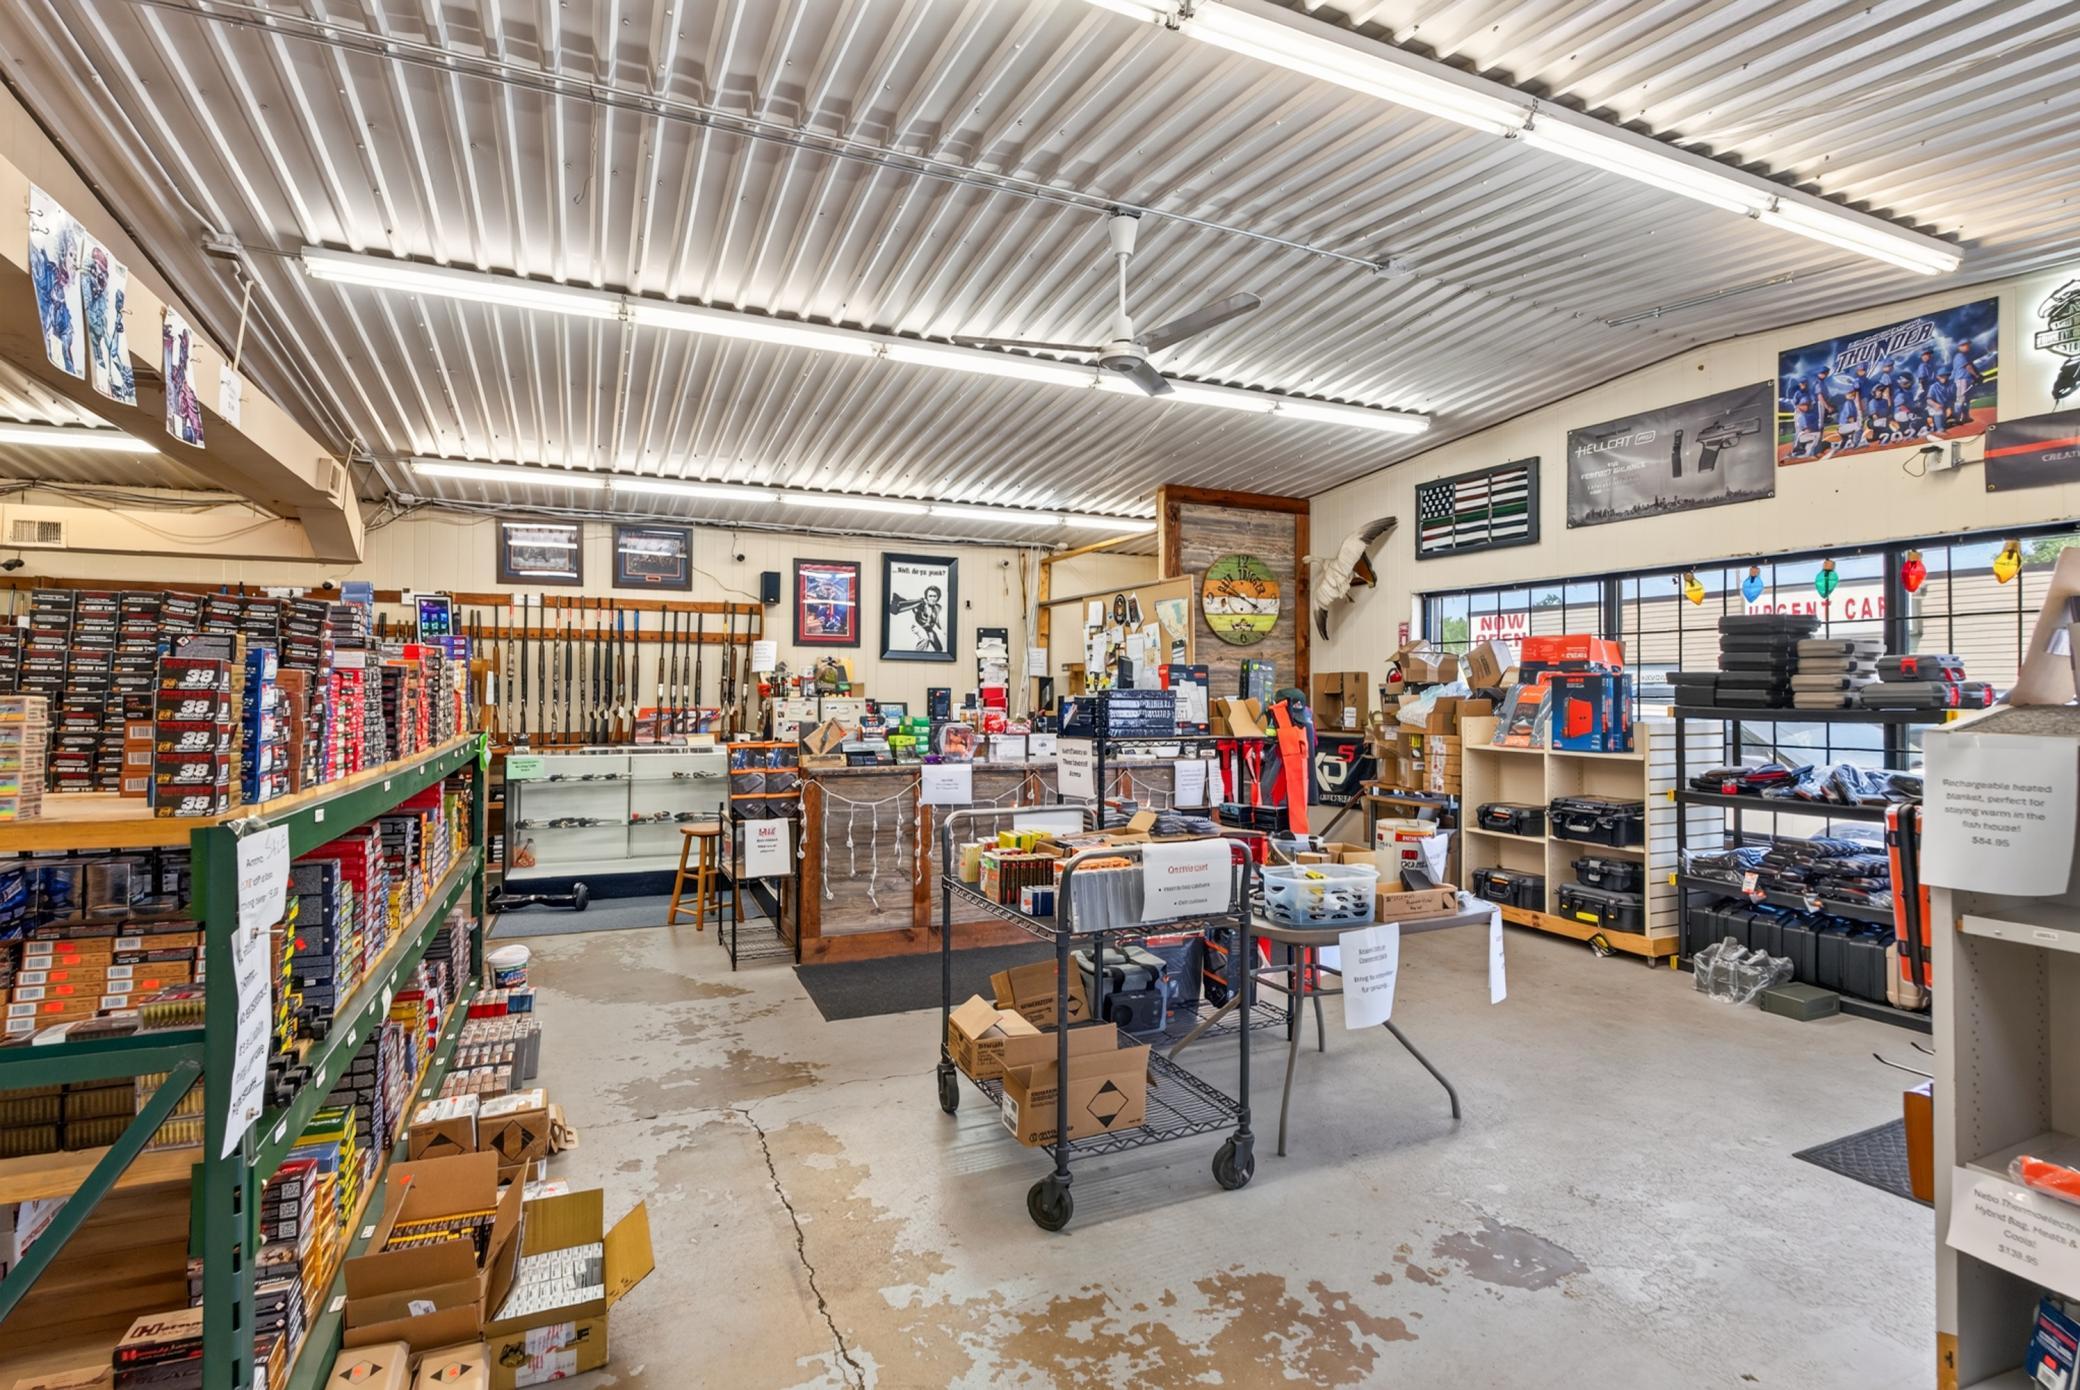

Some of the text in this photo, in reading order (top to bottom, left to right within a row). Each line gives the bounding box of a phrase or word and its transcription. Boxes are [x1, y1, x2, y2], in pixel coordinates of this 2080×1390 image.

[1834, 320, 1936, 379] THUNDER
[1575, 434, 1633, 458] HELLCAT
[1237, 556, 1250, 568] 12
[1480, 614, 1525, 631] NOW
[185, 669, 215, 683] 38
[180, 700, 210, 714] 38
[181, 731, 210, 745] 38
[180, 763, 209, 777] 38
[1942, 779, 2053, 793] Rechargeable heated
[181, 796, 210, 810] 38
[1987, 797, 2027, 807] perfect
[2029, 799, 2045, 807] for
[1944, 807, 1979, 818] staying
[1980, 809, 2011, 819] warm
[2026, 813, 2046, 821] the
[1962, 820, 1981, 829] fish
[1975, 1203, 2006, 1223] Hybrid
[2068, 1239, 2079, 1249] &
